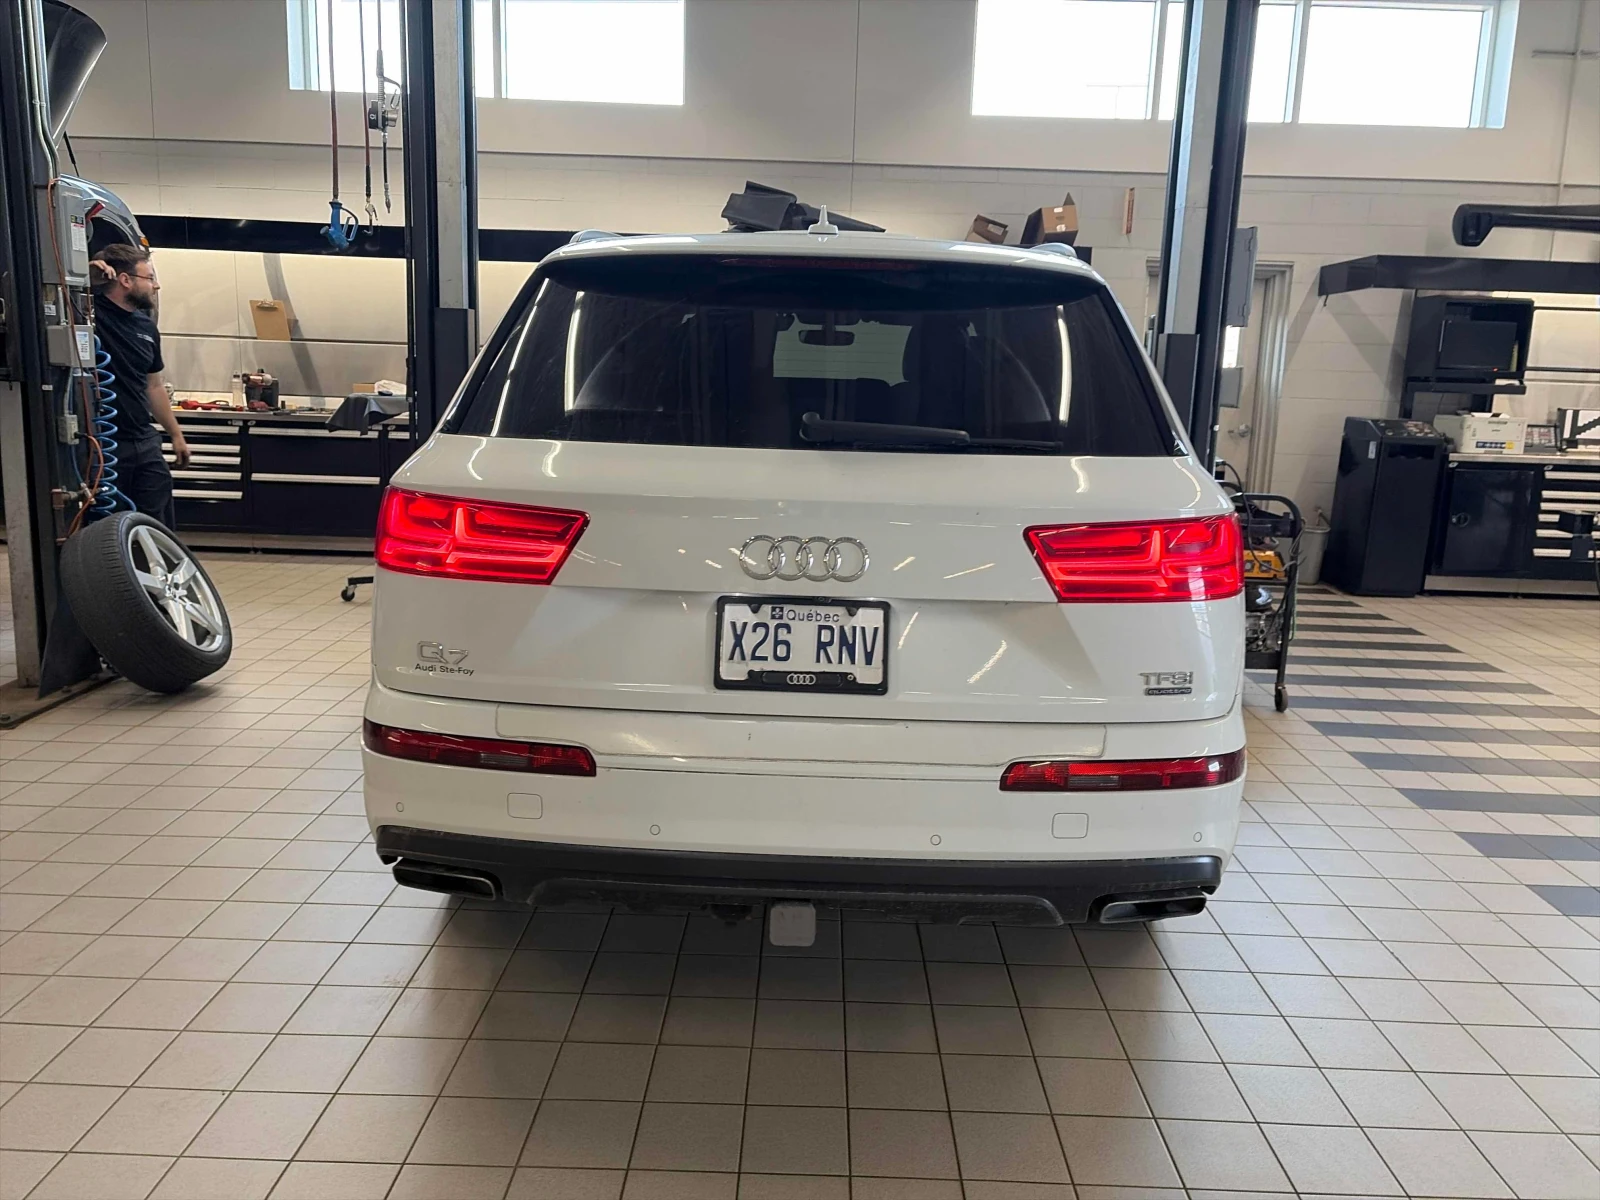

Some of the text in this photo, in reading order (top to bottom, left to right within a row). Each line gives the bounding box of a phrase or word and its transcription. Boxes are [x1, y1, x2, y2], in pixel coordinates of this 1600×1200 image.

[786, 608, 840, 623] Québec
[417, 641, 469, 665] Q7
[728, 621, 879, 666] X26 RNV
[414, 663, 475, 677] Audi Ste-Foy
